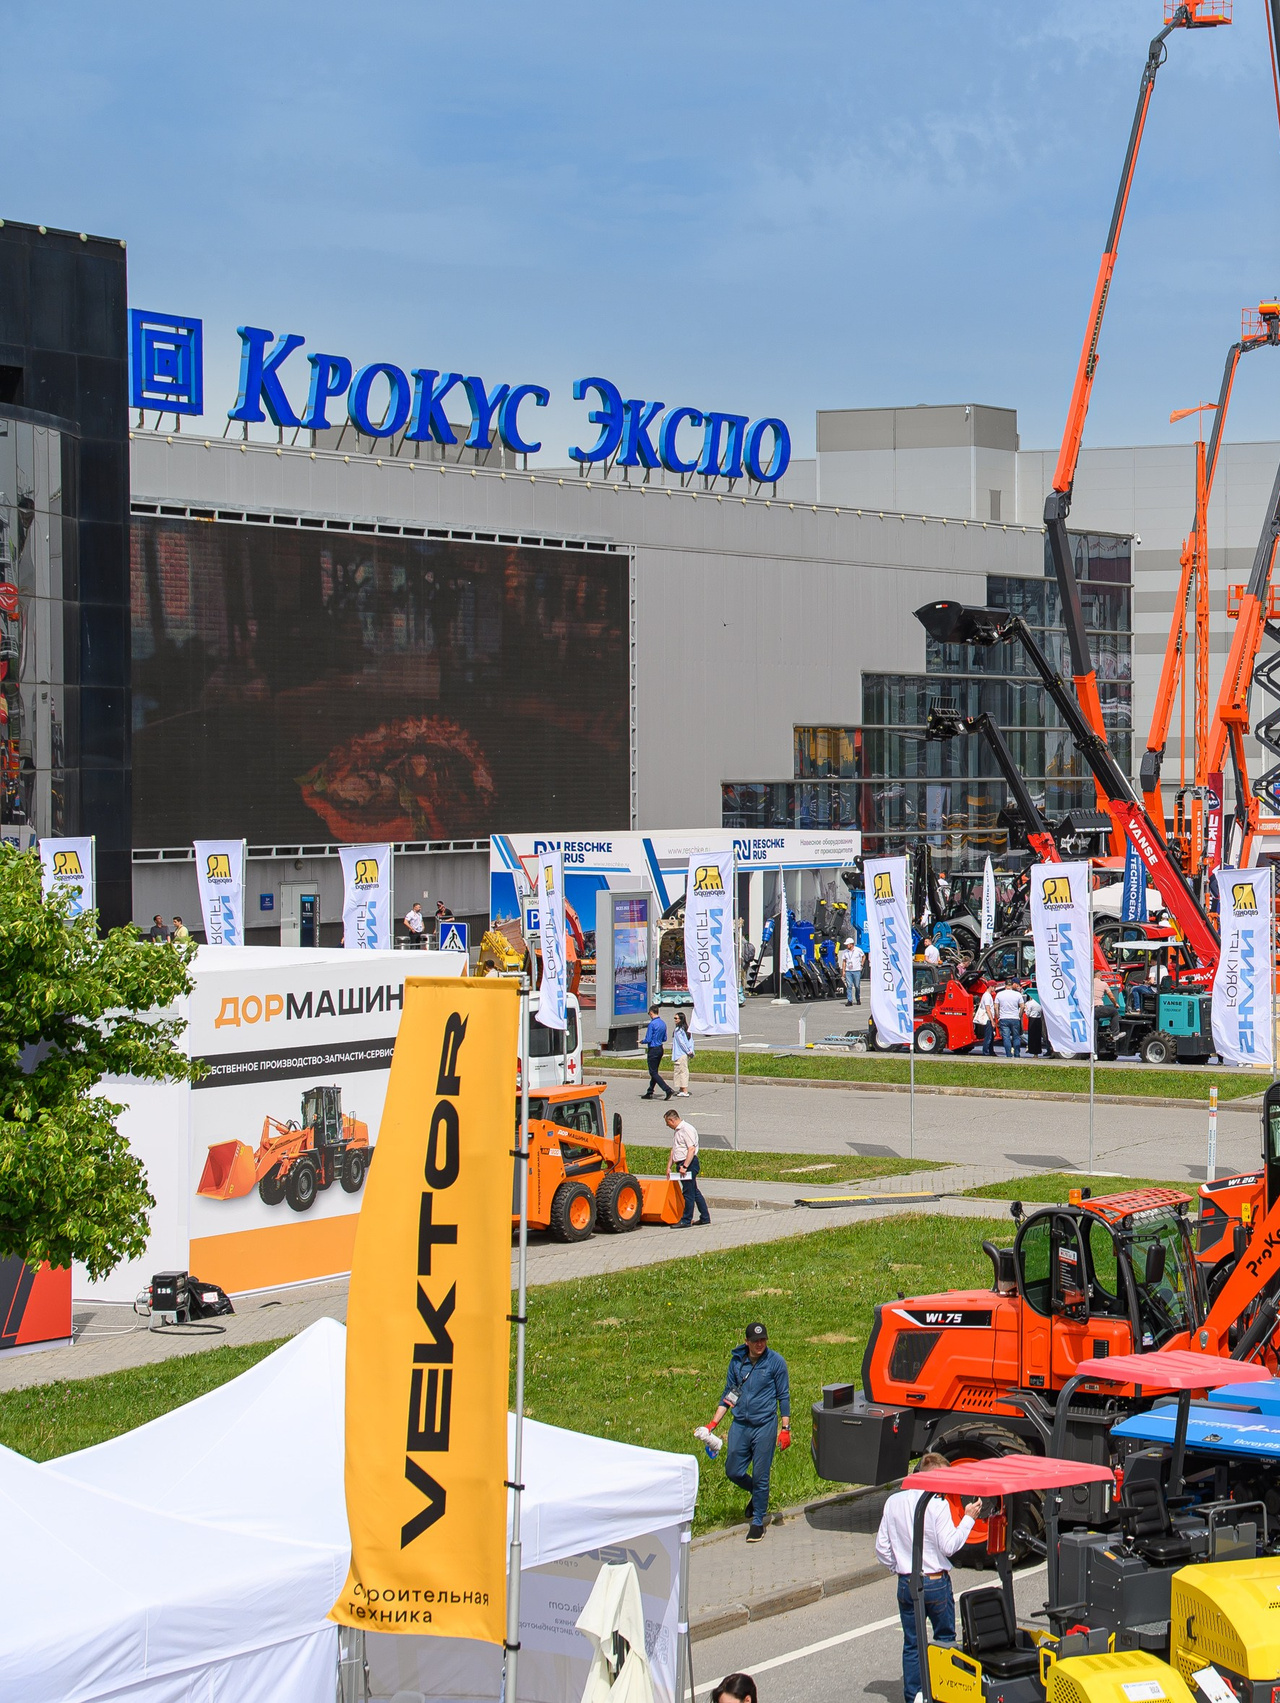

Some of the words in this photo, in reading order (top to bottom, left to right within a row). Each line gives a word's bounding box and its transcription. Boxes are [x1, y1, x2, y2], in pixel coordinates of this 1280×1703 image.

[563, 841, 613, 853] RESCHKE
[752, 839, 785, 849] RESCHKE
[822, 838, 853, 847] оборудование
[1128, 819, 1158, 866] VANSE
[563, 853, 585, 863] RUS
[752, 850, 767, 860] RUS
[1128, 857, 1138, 920] TECHNOERA
[214, 984, 404, 1029] ДОРМАШИН
[400, 1012, 468, 1550] VEKTOR
[925, 1313, 963, 1323] WL75
[349, 1601, 433, 1623] техника
[946, 1679, 972, 1692] VEKTOR
